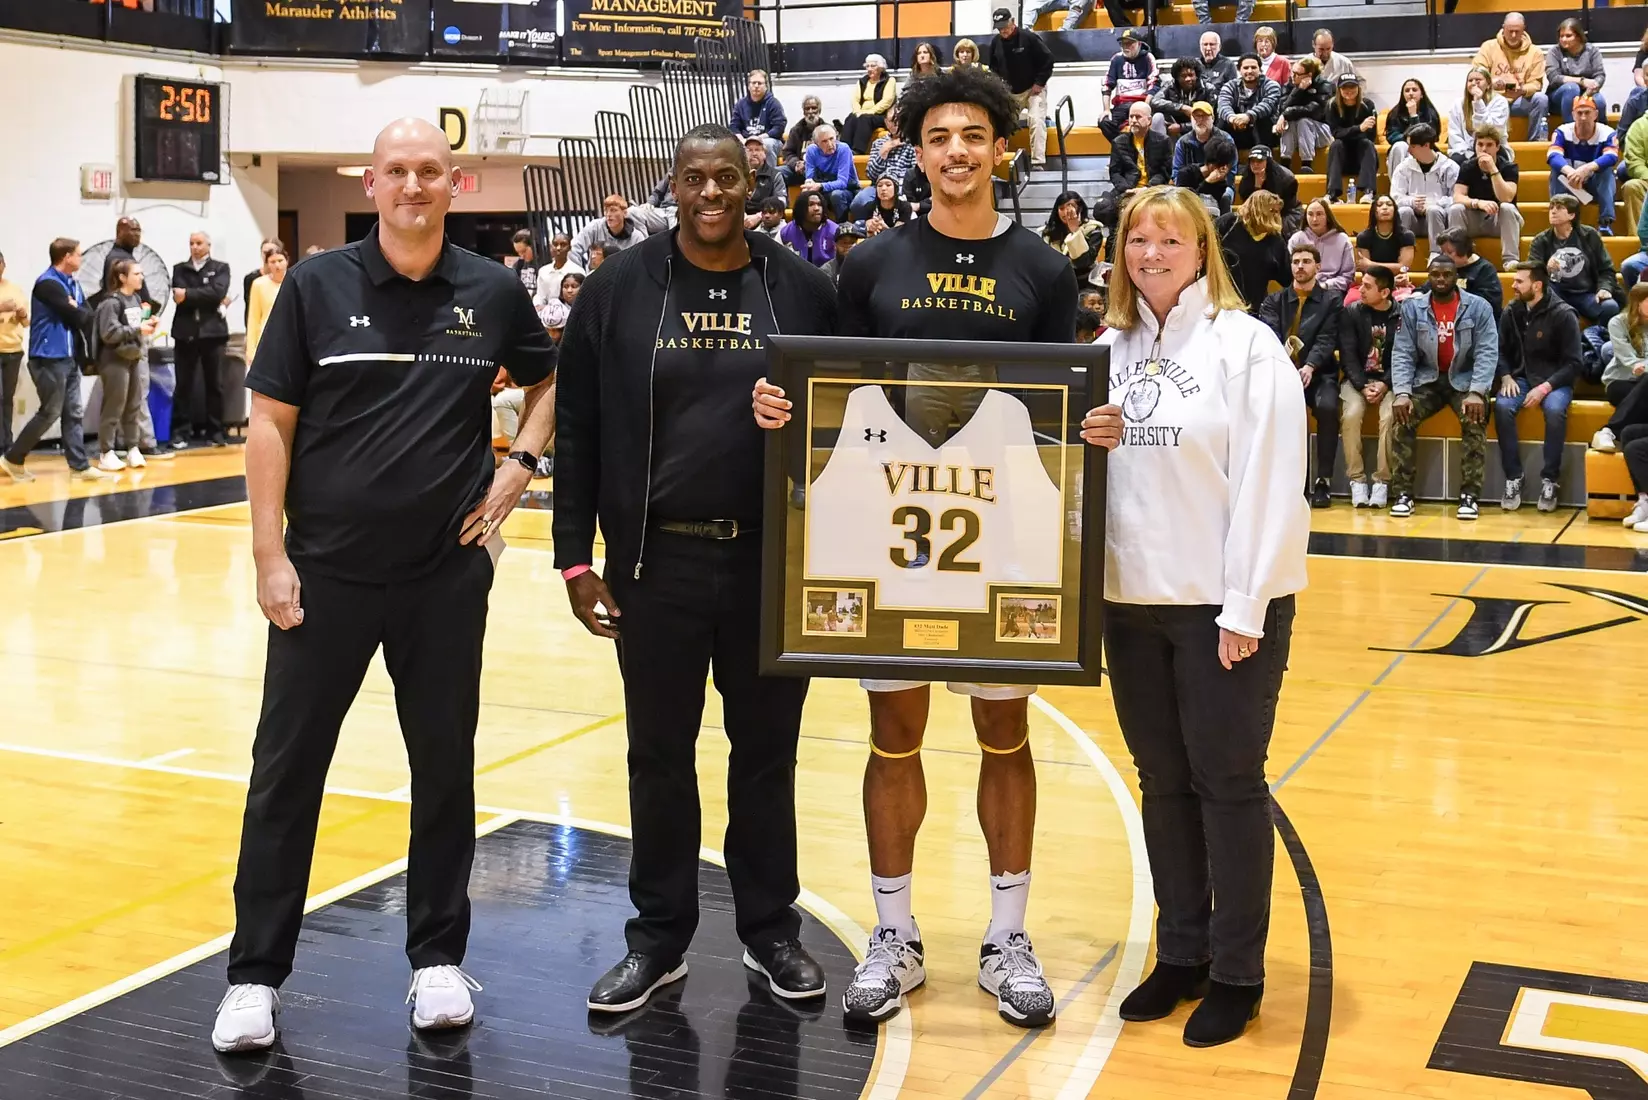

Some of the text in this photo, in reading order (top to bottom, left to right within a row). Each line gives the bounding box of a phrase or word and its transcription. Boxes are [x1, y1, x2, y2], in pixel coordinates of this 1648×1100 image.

[265, 2, 397, 20] Marauder Athletics
[591, 0, 717, 16] MANAGEMENT
[499, 31, 519, 39] MAKE
[526, 28, 555, 43] YOURS
[571, 20, 586, 31] For
[589, 21, 611, 32] More
[613, 22, 665, 35] Information,
[667, 25, 681, 35] call
[160, 85, 211, 123] 2:50
[440, 107, 467, 151] D
[926, 273, 997, 301] VILLE
[901, 297, 1017, 321] BASKETBALL
[445, 329, 483, 337] BASKETBALL
[681, 312, 753, 336] VILLE
[656, 337, 765, 350] BASKETBAL
[1120, 426, 1183, 446] VERSITY
[880, 461, 998, 505] VILLE
[889, 504, 982, 573] 32
